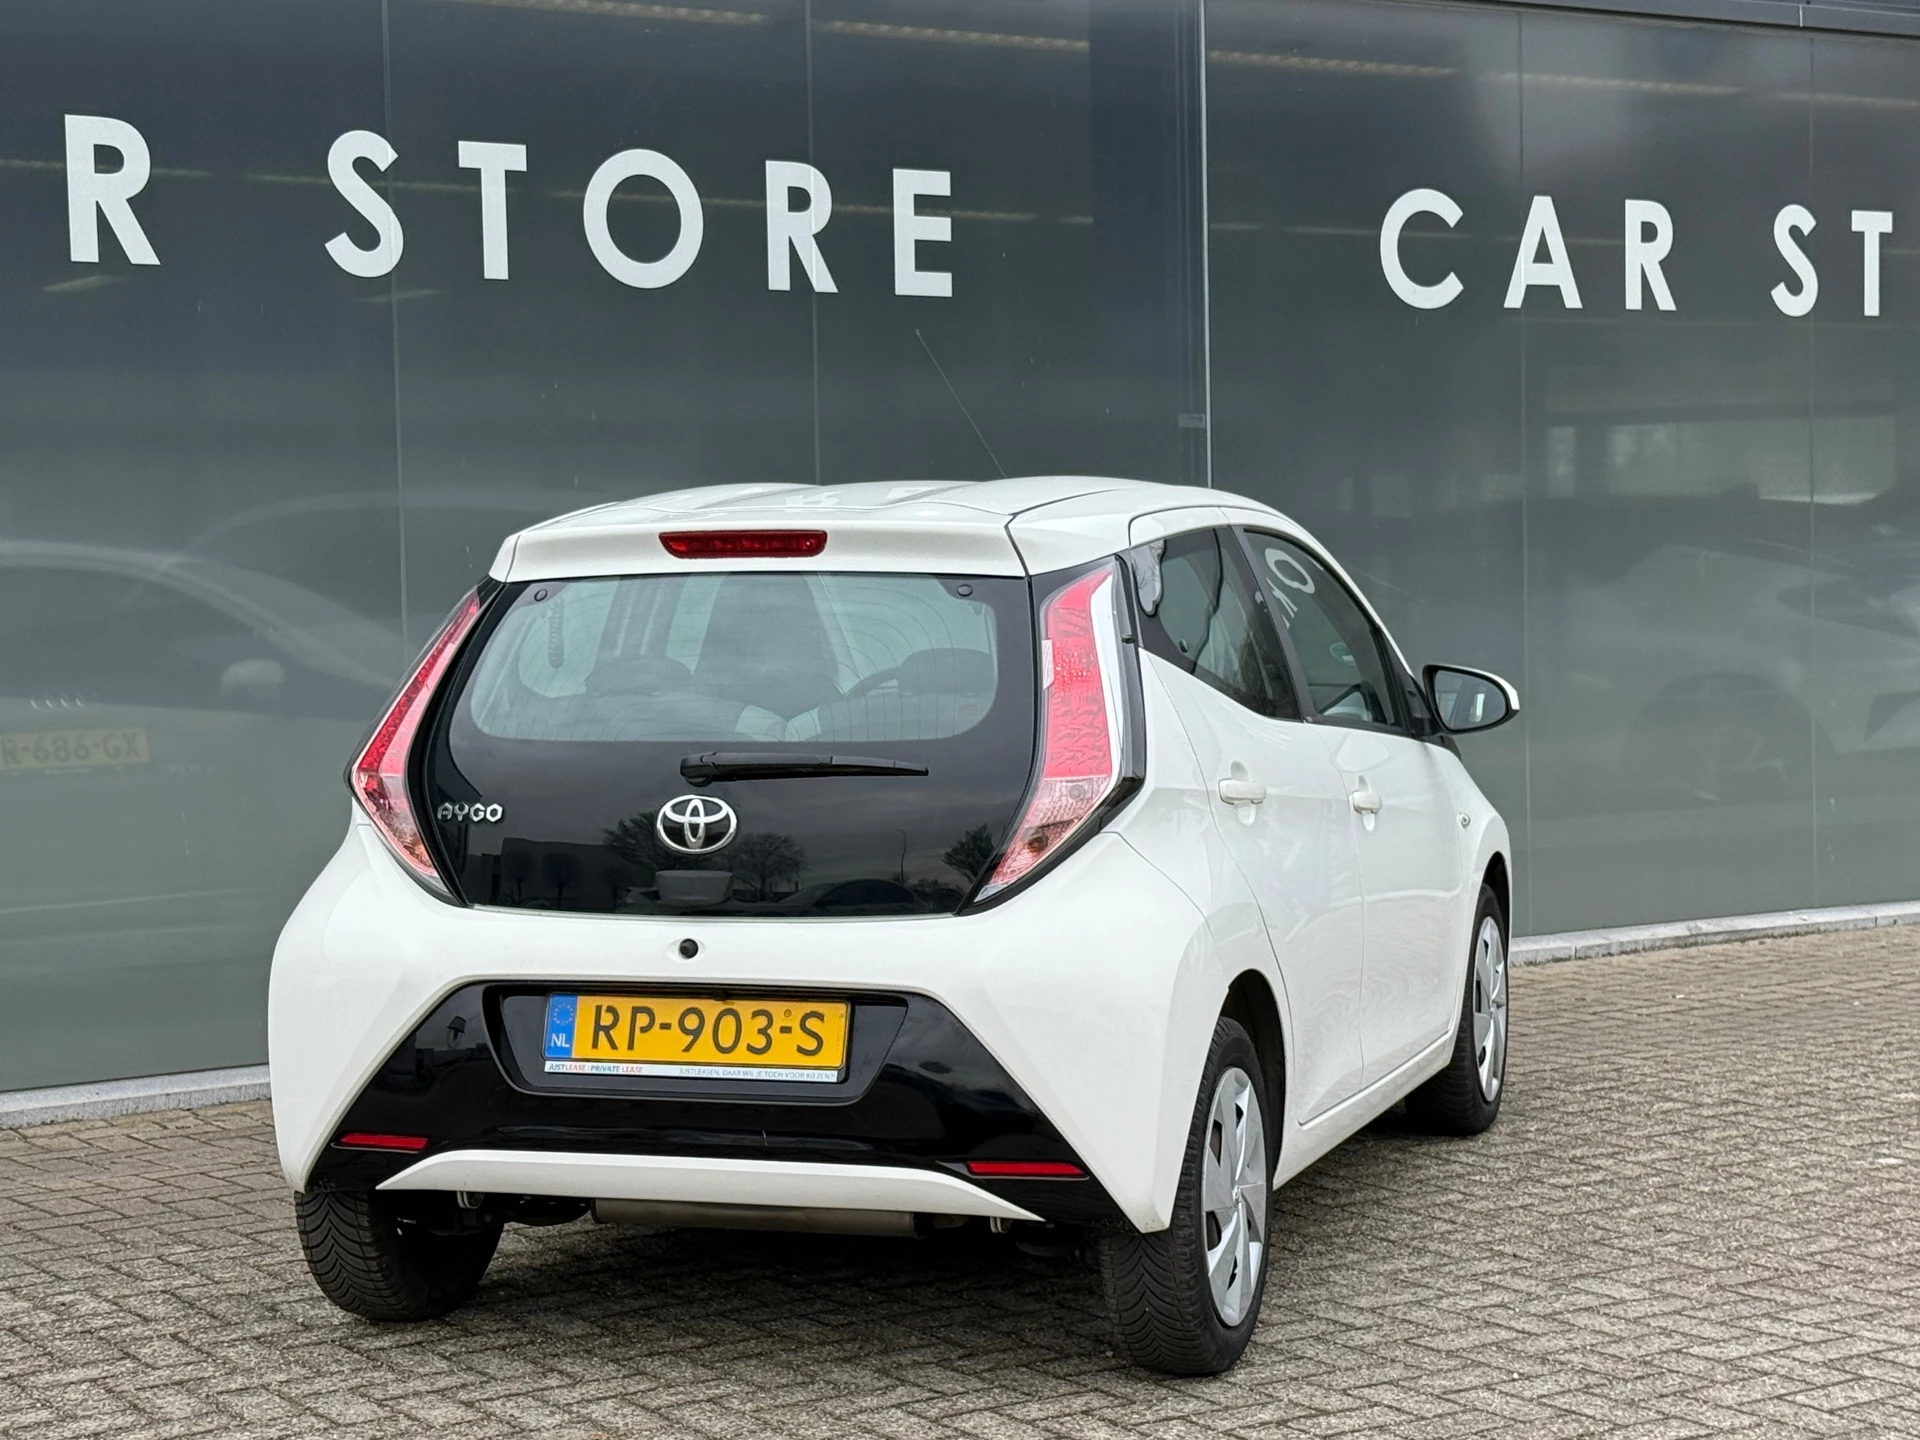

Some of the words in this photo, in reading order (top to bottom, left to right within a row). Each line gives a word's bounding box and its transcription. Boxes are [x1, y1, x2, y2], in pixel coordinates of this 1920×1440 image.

[325, 130, 953, 298] STORE
[1380, 188, 1677, 311] CAR
[1770, 204, 1894, 317] ST
[436, 801, 504, 823] AYGO
[550, 1032, 570, 1048] NL
[592, 1003, 826, 1057] RP-903-S
[590, 1065, 621, 1073] PRIVATE
[621, 1066, 644, 1074] LEASE
